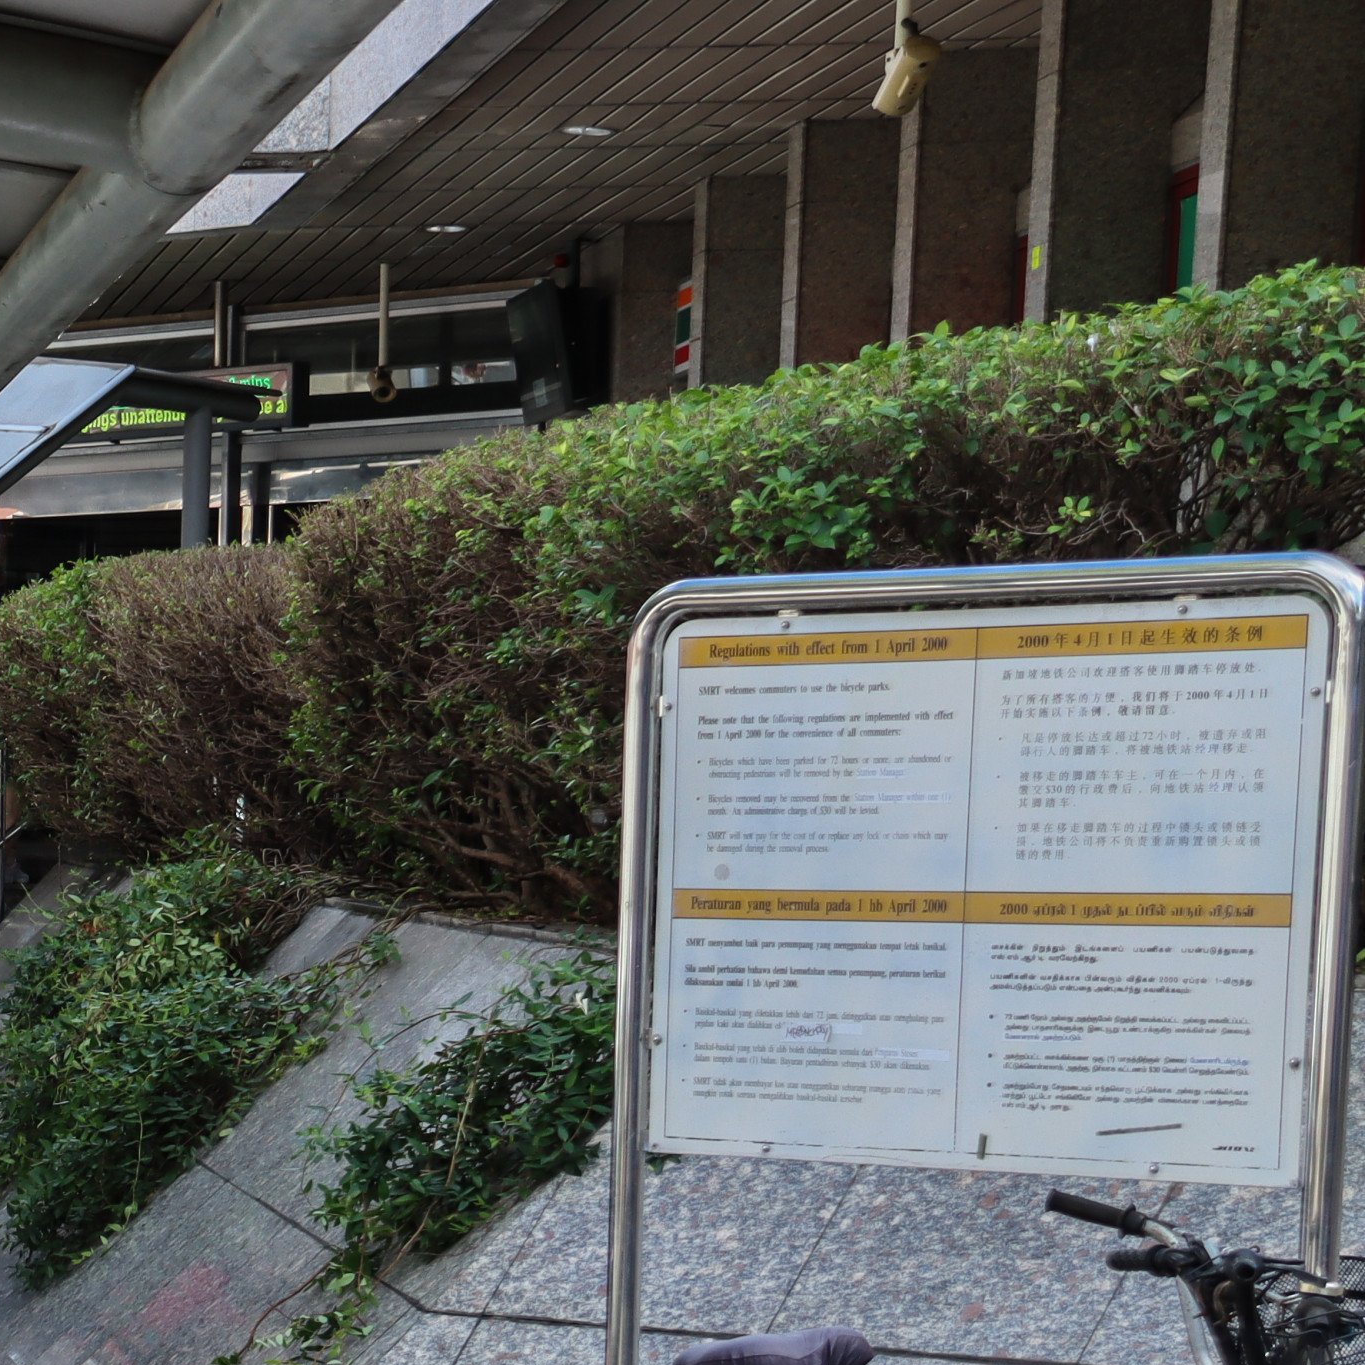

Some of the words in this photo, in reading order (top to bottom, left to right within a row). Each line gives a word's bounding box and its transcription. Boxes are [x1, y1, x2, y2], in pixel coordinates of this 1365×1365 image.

[709, 643, 771, 661] Regulations
[776, 642, 800, 655] with
[805, 641, 835, 654] effect
[840, 640, 869, 653] from
[875, 640, 882, 652] 1
[887, 638, 916, 655] April
[921, 637, 947, 650] 2000
[698, 687, 720, 695] SMRT
[724, 686, 756, 694] welcomes
[758, 685, 797, 693] commuters
[799, 684, 808, 693] to
[825, 684, 837, 692] the
[839, 683, 864, 694] bicycle
[867, 682, 890, 694] parks.
[698, 716, 719, 724] Please
[721, 716, 737, 724] note
[740, 715, 755, 723] that
[757, 715, 769, 723] the
[772, 714, 804, 725] following
[807, 713, 846, 724] regulations
[864, 712, 911, 723] implemented
[914, 712, 930, 720] with
[933, 711, 953, 720] effect
[697, 730, 714, 739] from
[724, 730, 743, 741] April
[745, 730, 762, 738] 2000
[764, 730, 775, 738] for
[777, 729, 789, 738] the
[792, 729, 833, 737] convenience
[836, 729, 845, 737] of
[846, 729, 857, 737] all
[859, 728, 901, 736] commuters:
[691, 896, 742, 910] Peraturan
[747, 901, 772, 914] yang
[776, 898, 821, 911] bermula
[825, 898, 853, 915] pada
[857, 899, 864, 911] 1
[868, 899, 883, 912] hb
[889, 899, 917, 915] April
[922, 900, 947, 912] 2000
[999, 904, 1028, 916] 2000
